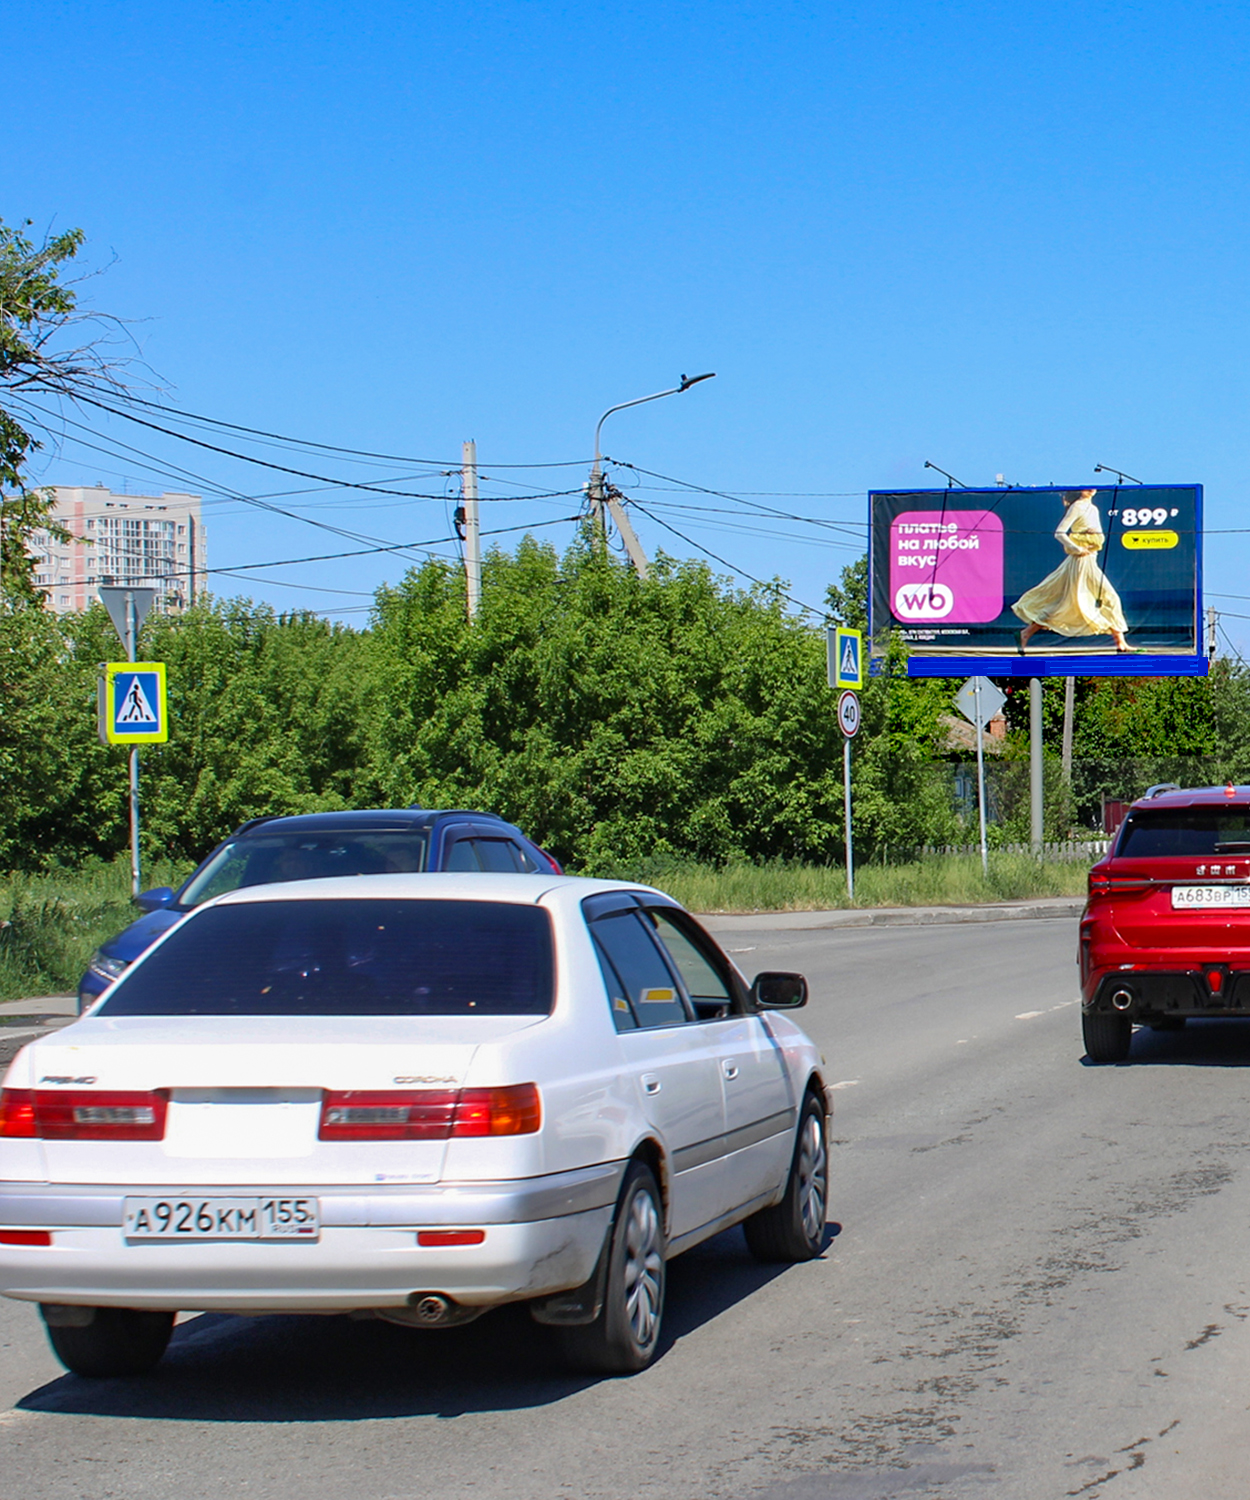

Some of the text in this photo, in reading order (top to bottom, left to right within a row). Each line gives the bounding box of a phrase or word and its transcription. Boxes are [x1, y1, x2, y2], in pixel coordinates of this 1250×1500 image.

[1108, 509, 1119, 517] от
[898, 522, 958, 534] платье
[898, 535, 980, 550] на любой
[1142, 537, 1170, 545] купить
[898, 554, 937, 569] вкус
[843, 705, 856, 723] 40
[1177, 888, 1231, 902] А683ВР
[135, 1200, 308, 1232] А926КМ 155
